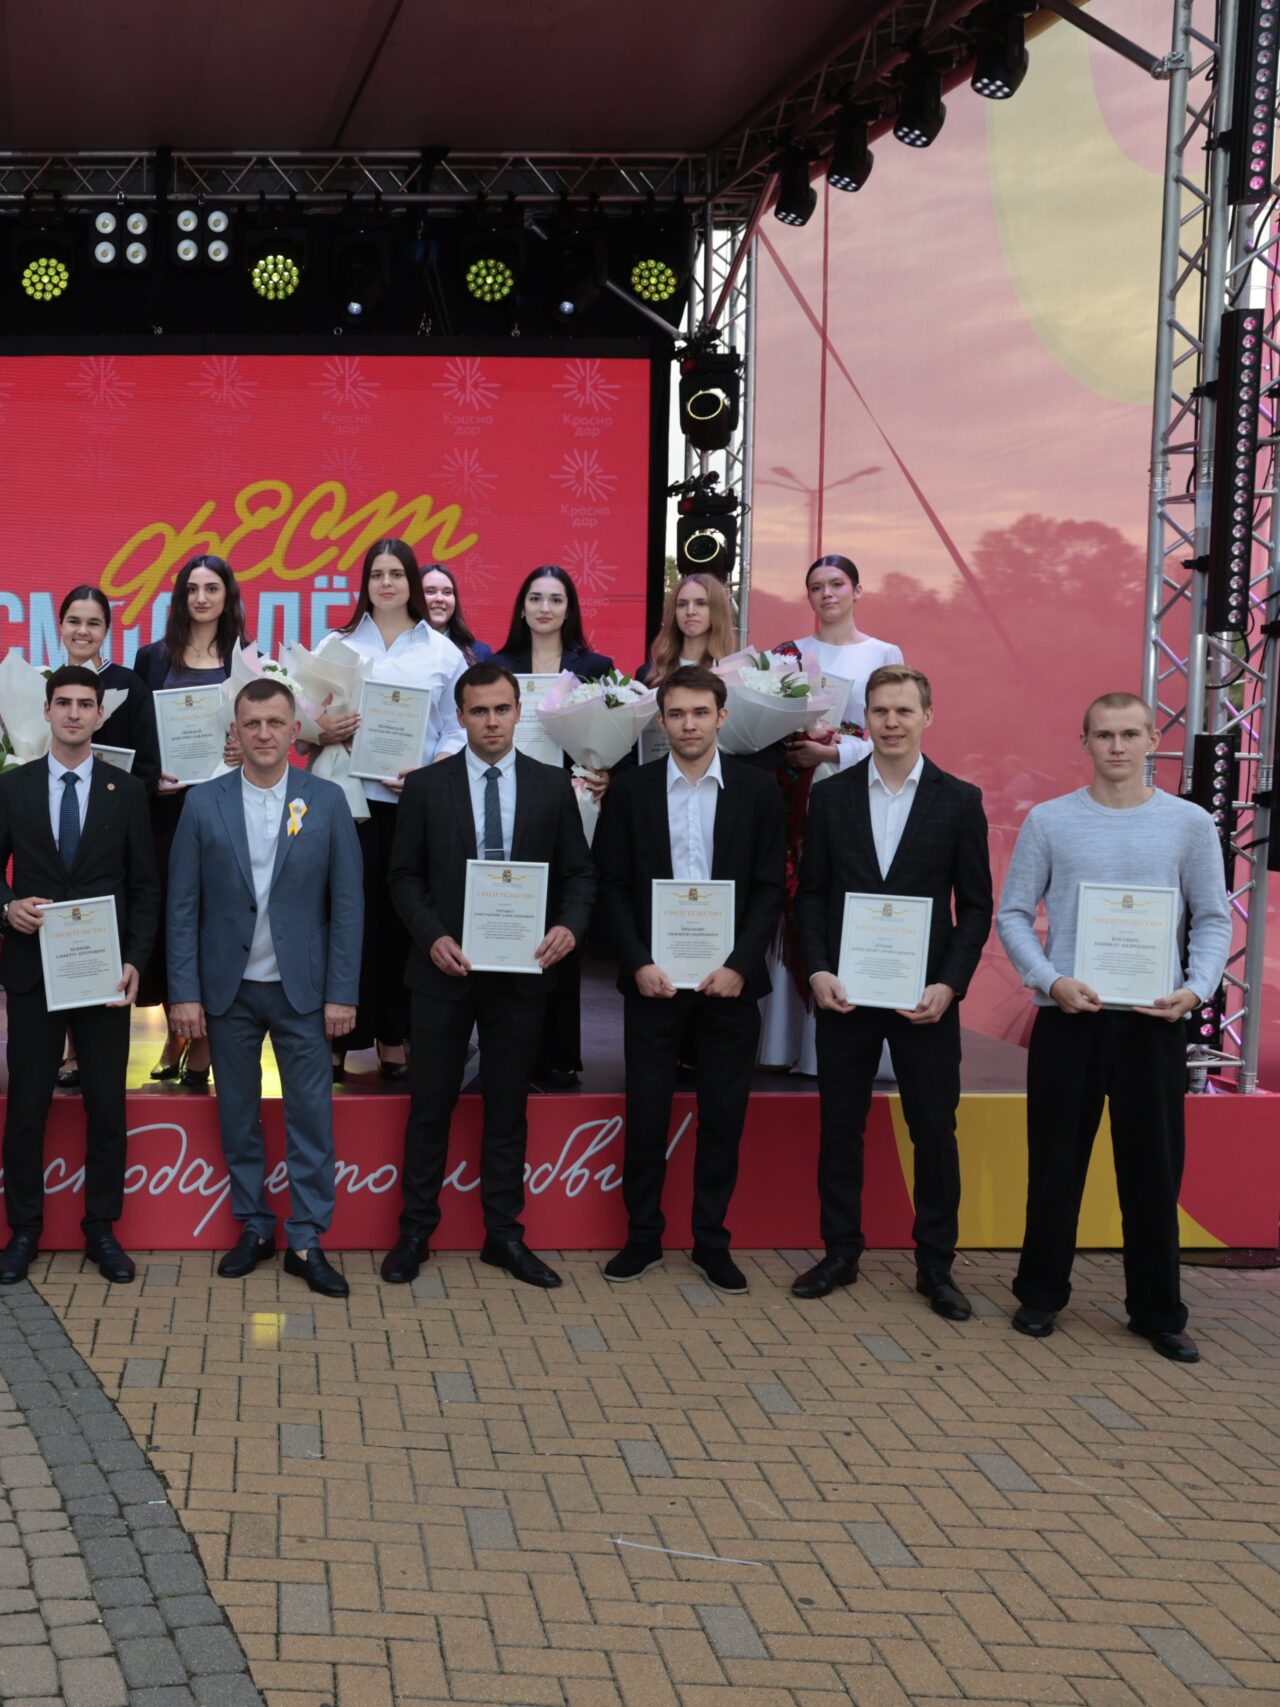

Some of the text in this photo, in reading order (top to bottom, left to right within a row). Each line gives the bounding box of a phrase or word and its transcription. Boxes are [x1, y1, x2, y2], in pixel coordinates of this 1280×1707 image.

[562, 413, 613, 427] Красно
[560, 505, 611, 518] Красно
[572, 517, 599, 529] дар
